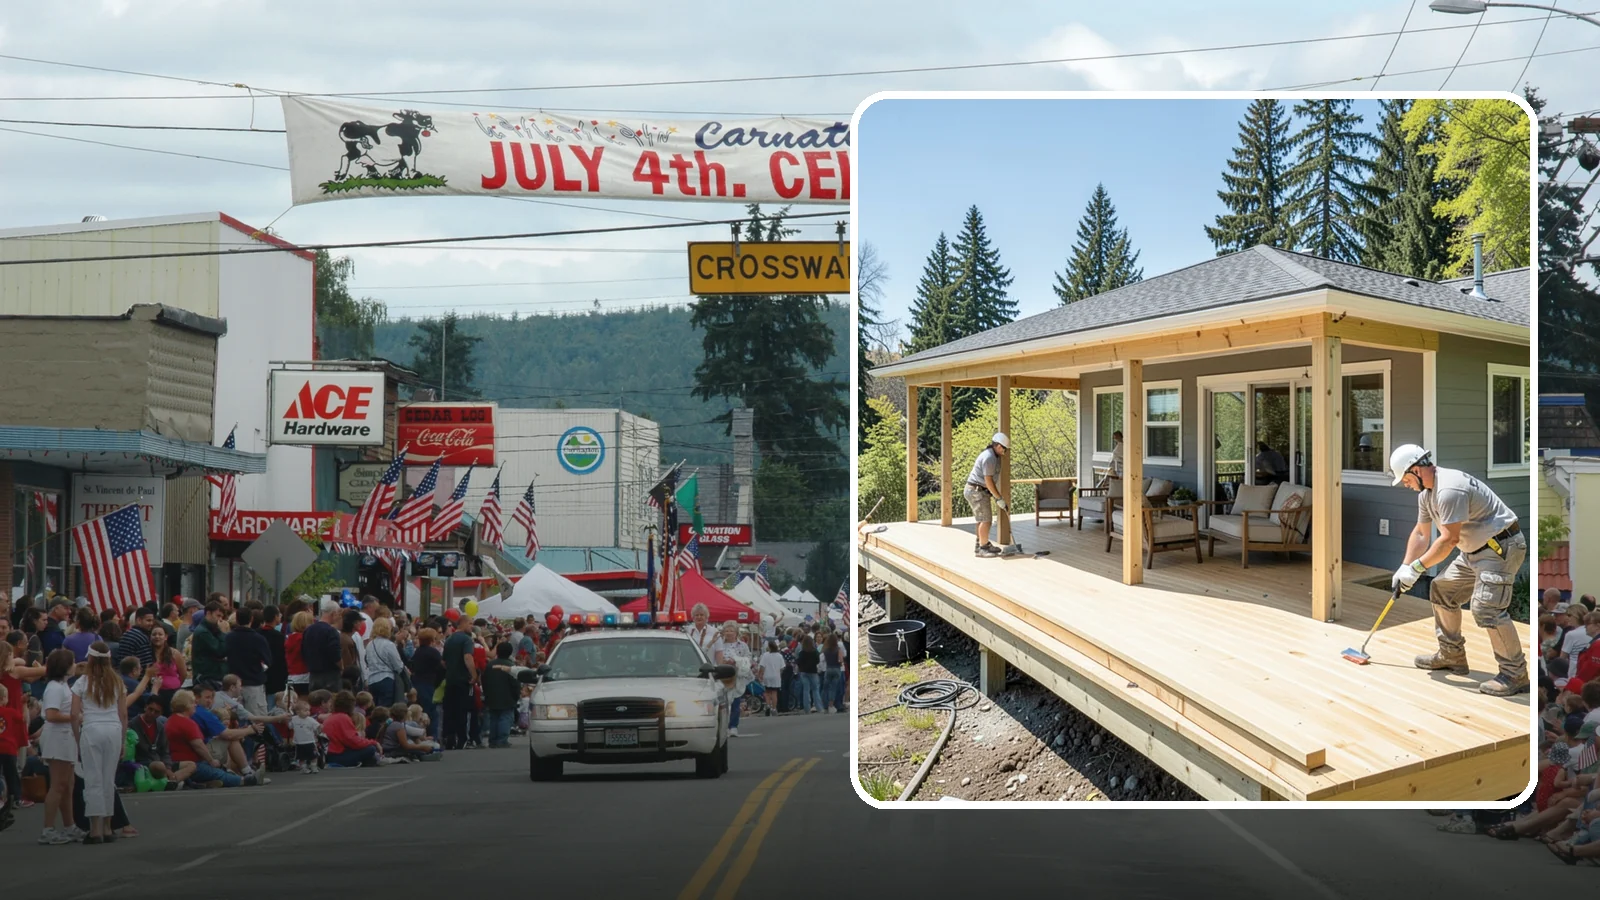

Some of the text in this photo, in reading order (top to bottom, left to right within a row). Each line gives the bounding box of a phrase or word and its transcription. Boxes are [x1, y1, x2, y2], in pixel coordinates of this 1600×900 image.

[481, 141, 605, 192] JULY
[632, 150, 746, 198] 4th.
[696, 254, 850, 280] CROSSWA
[282, 380, 373, 420] ACE
[406, 409, 452, 421] CEDAR
[283, 421, 371, 437] Hardware
[416, 428, 477, 446] Coca-Cola
[353, 467, 385, 480] Simpl
[95, 485, 124, 495] Vincent
[126, 485, 136, 495] de
[137, 486, 155, 495] Paul
[688, 526, 741, 535] CRNATION
[699, 535, 730, 543] GLASS
